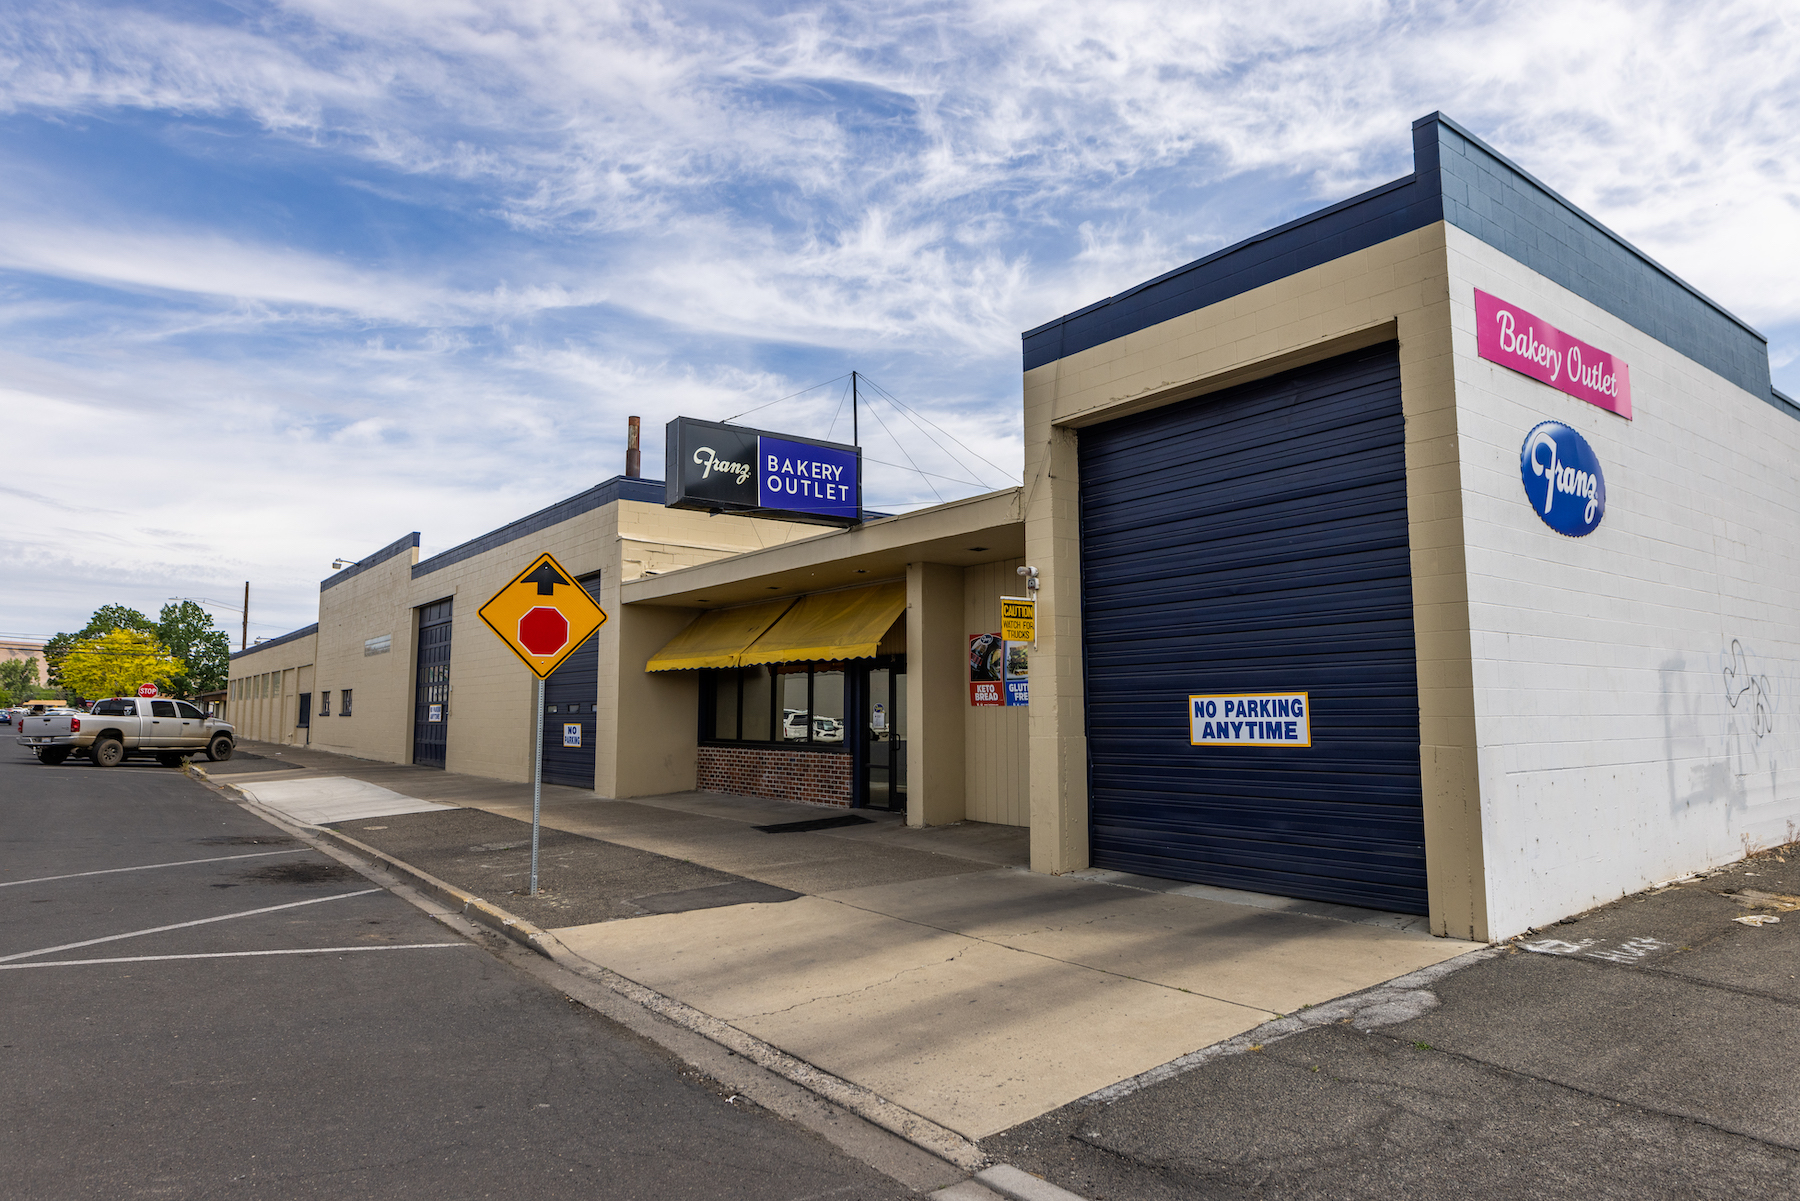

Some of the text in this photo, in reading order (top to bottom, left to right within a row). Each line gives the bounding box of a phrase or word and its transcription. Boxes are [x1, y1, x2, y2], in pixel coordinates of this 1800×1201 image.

[1497, 310, 1618, 397] Bakery Outlet
[693, 446, 751, 485] Franz
[767, 455, 843, 482] BAKERY
[1531, 432, 1598, 525] Franz
[767, 475, 849, 502] OUTLET
[1003, 605, 1033, 618] CAUTION
[1003, 620, 1033, 630] WATCH FOR
[1007, 630, 1030, 639] TRUCKS
[975, 692, 998, 701] BREAD
[976, 684, 995, 693] KETO
[1194, 698, 1304, 719] NO PARKING
[567, 726, 577, 735] NO
[1202, 721, 1298, 740] ANYTIME
